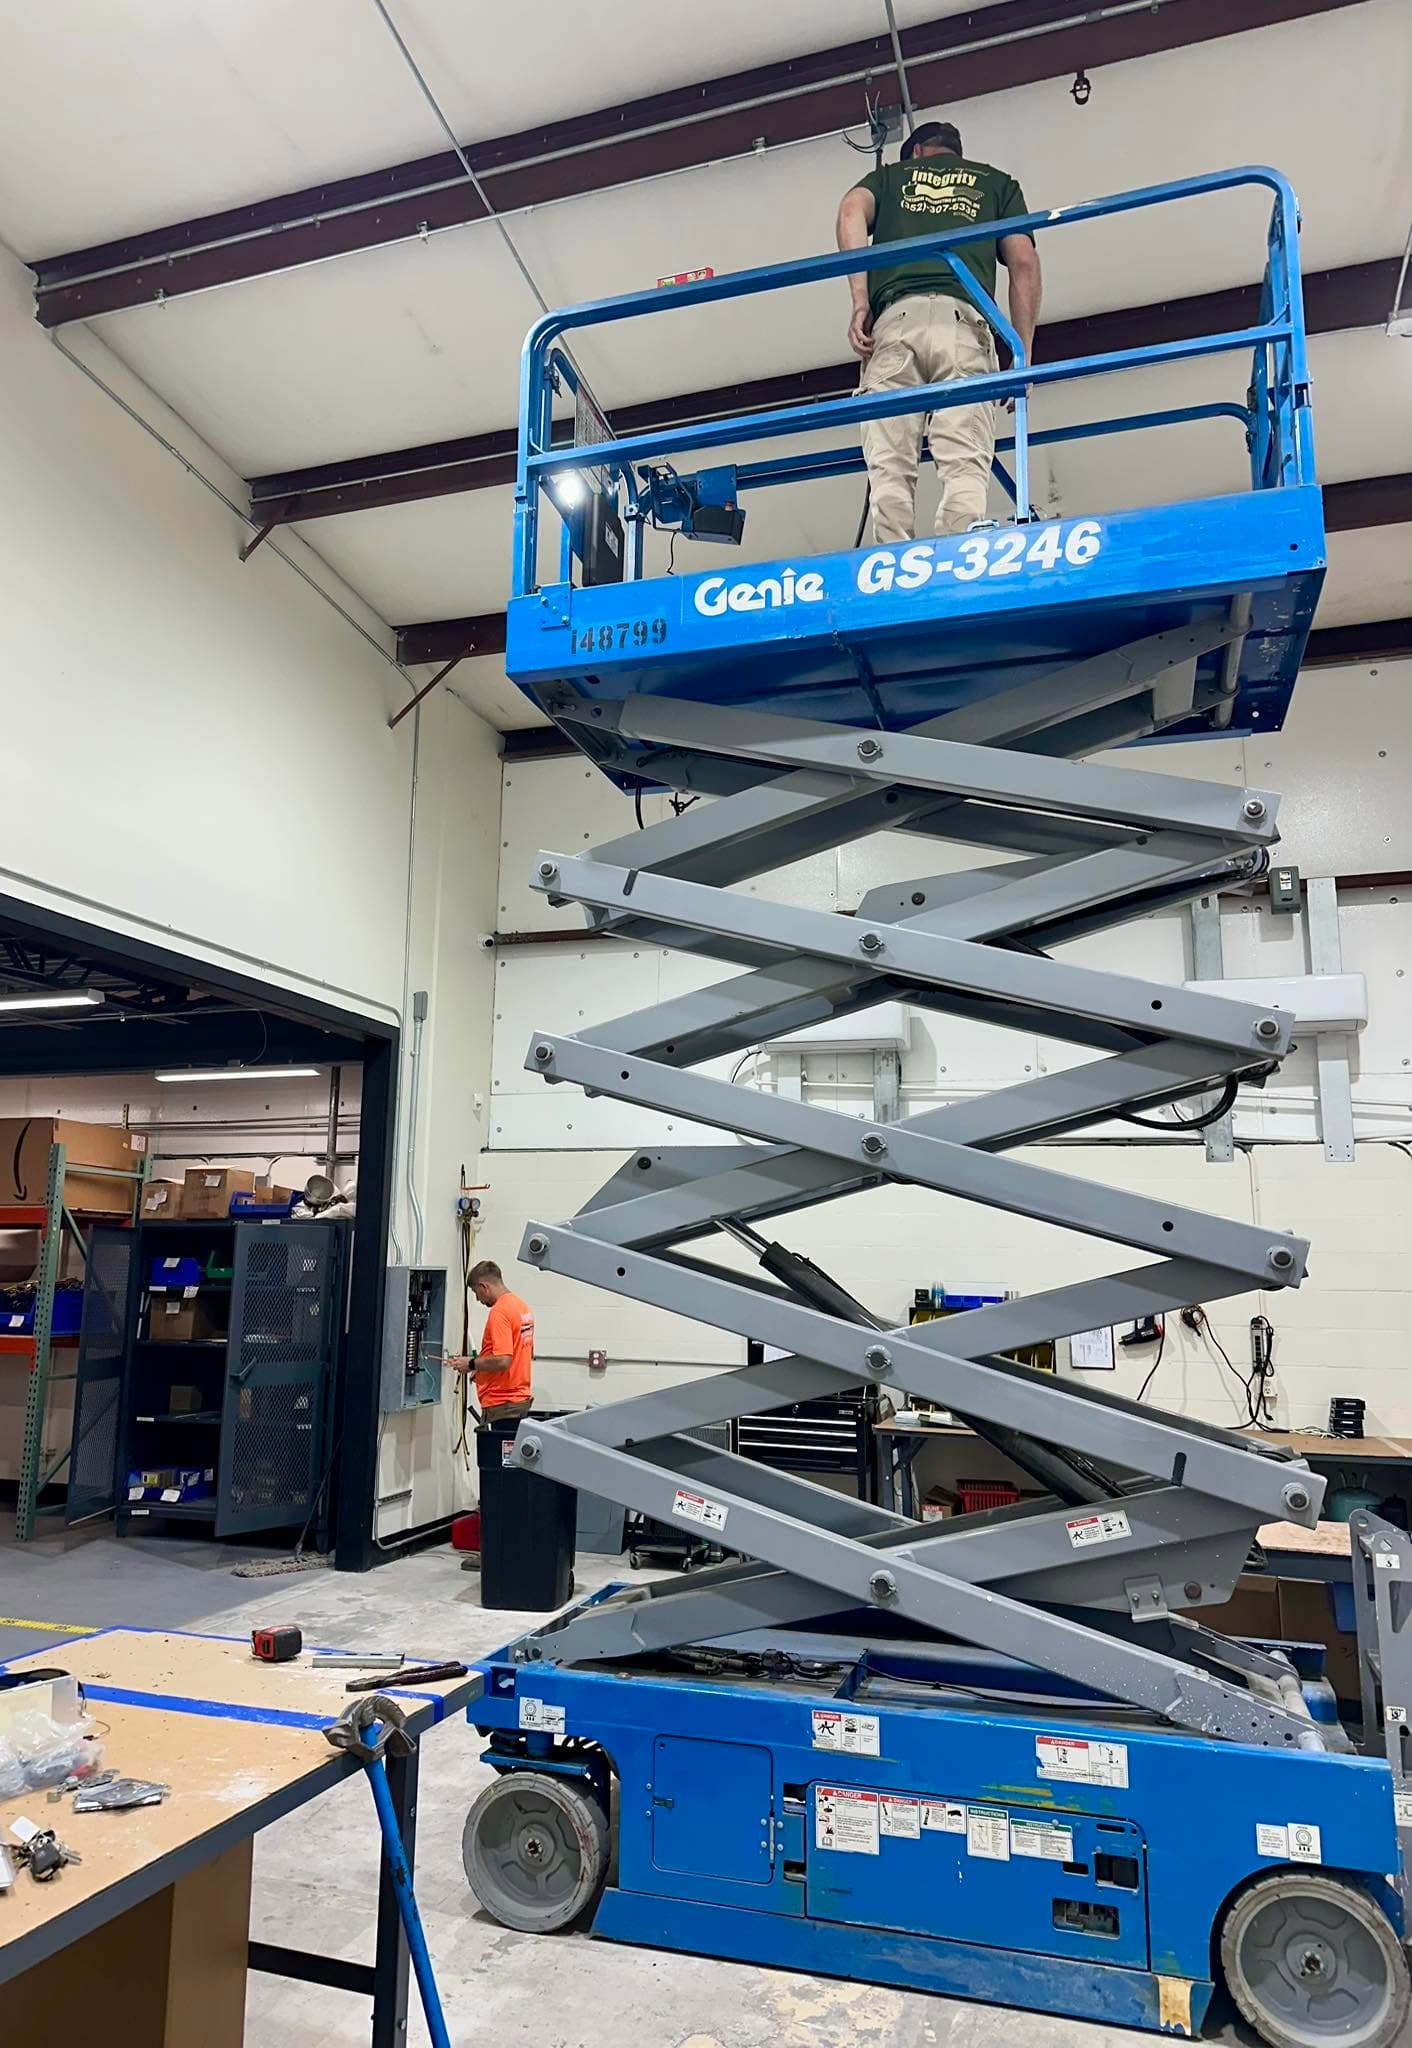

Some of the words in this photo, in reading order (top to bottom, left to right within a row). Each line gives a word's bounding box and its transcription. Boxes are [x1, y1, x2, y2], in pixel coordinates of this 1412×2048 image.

[911, 169, 977, 187] Integrity
[694, 567, 825, 617] Genie
[856, 521, 1102, 594] GS-3246
[837, 1790, 862, 1799] DANGER
[969, 1808, 1006, 1818] INSTRUCTIONS
